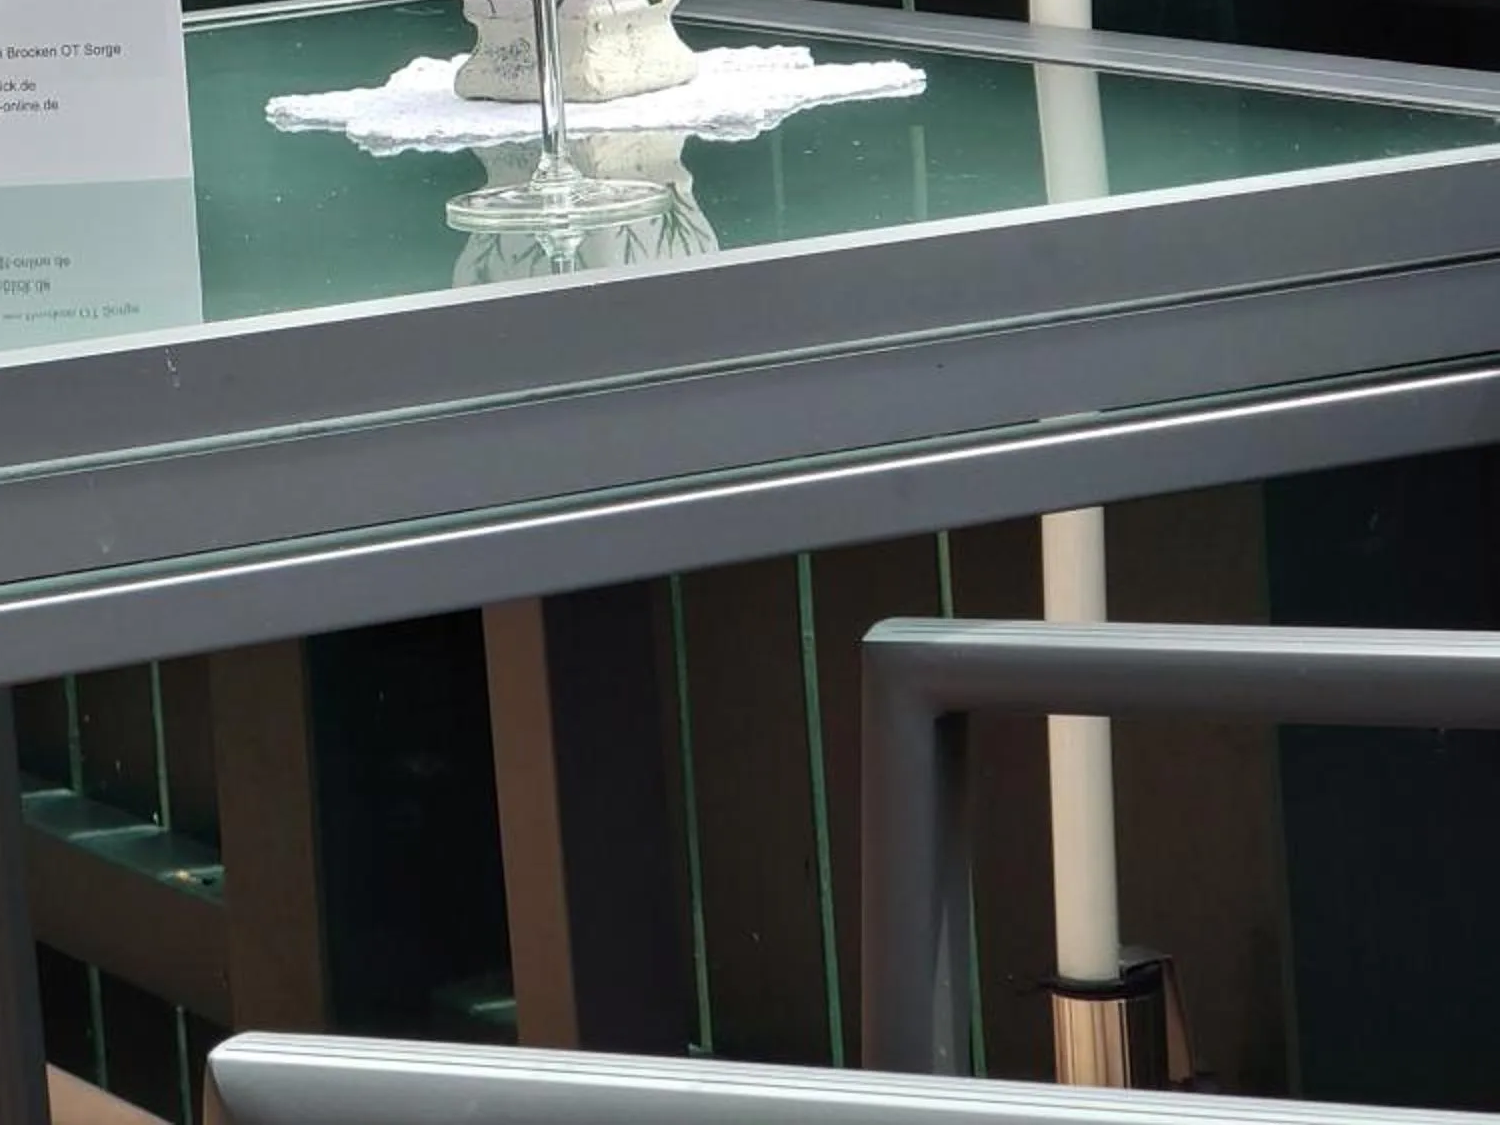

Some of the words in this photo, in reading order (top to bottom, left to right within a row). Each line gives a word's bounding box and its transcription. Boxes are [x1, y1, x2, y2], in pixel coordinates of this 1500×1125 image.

[7, 45, 57, 59] Brocken
[61, 44, 81, 57] OT
[84, 43, 121, 57] Sorge
